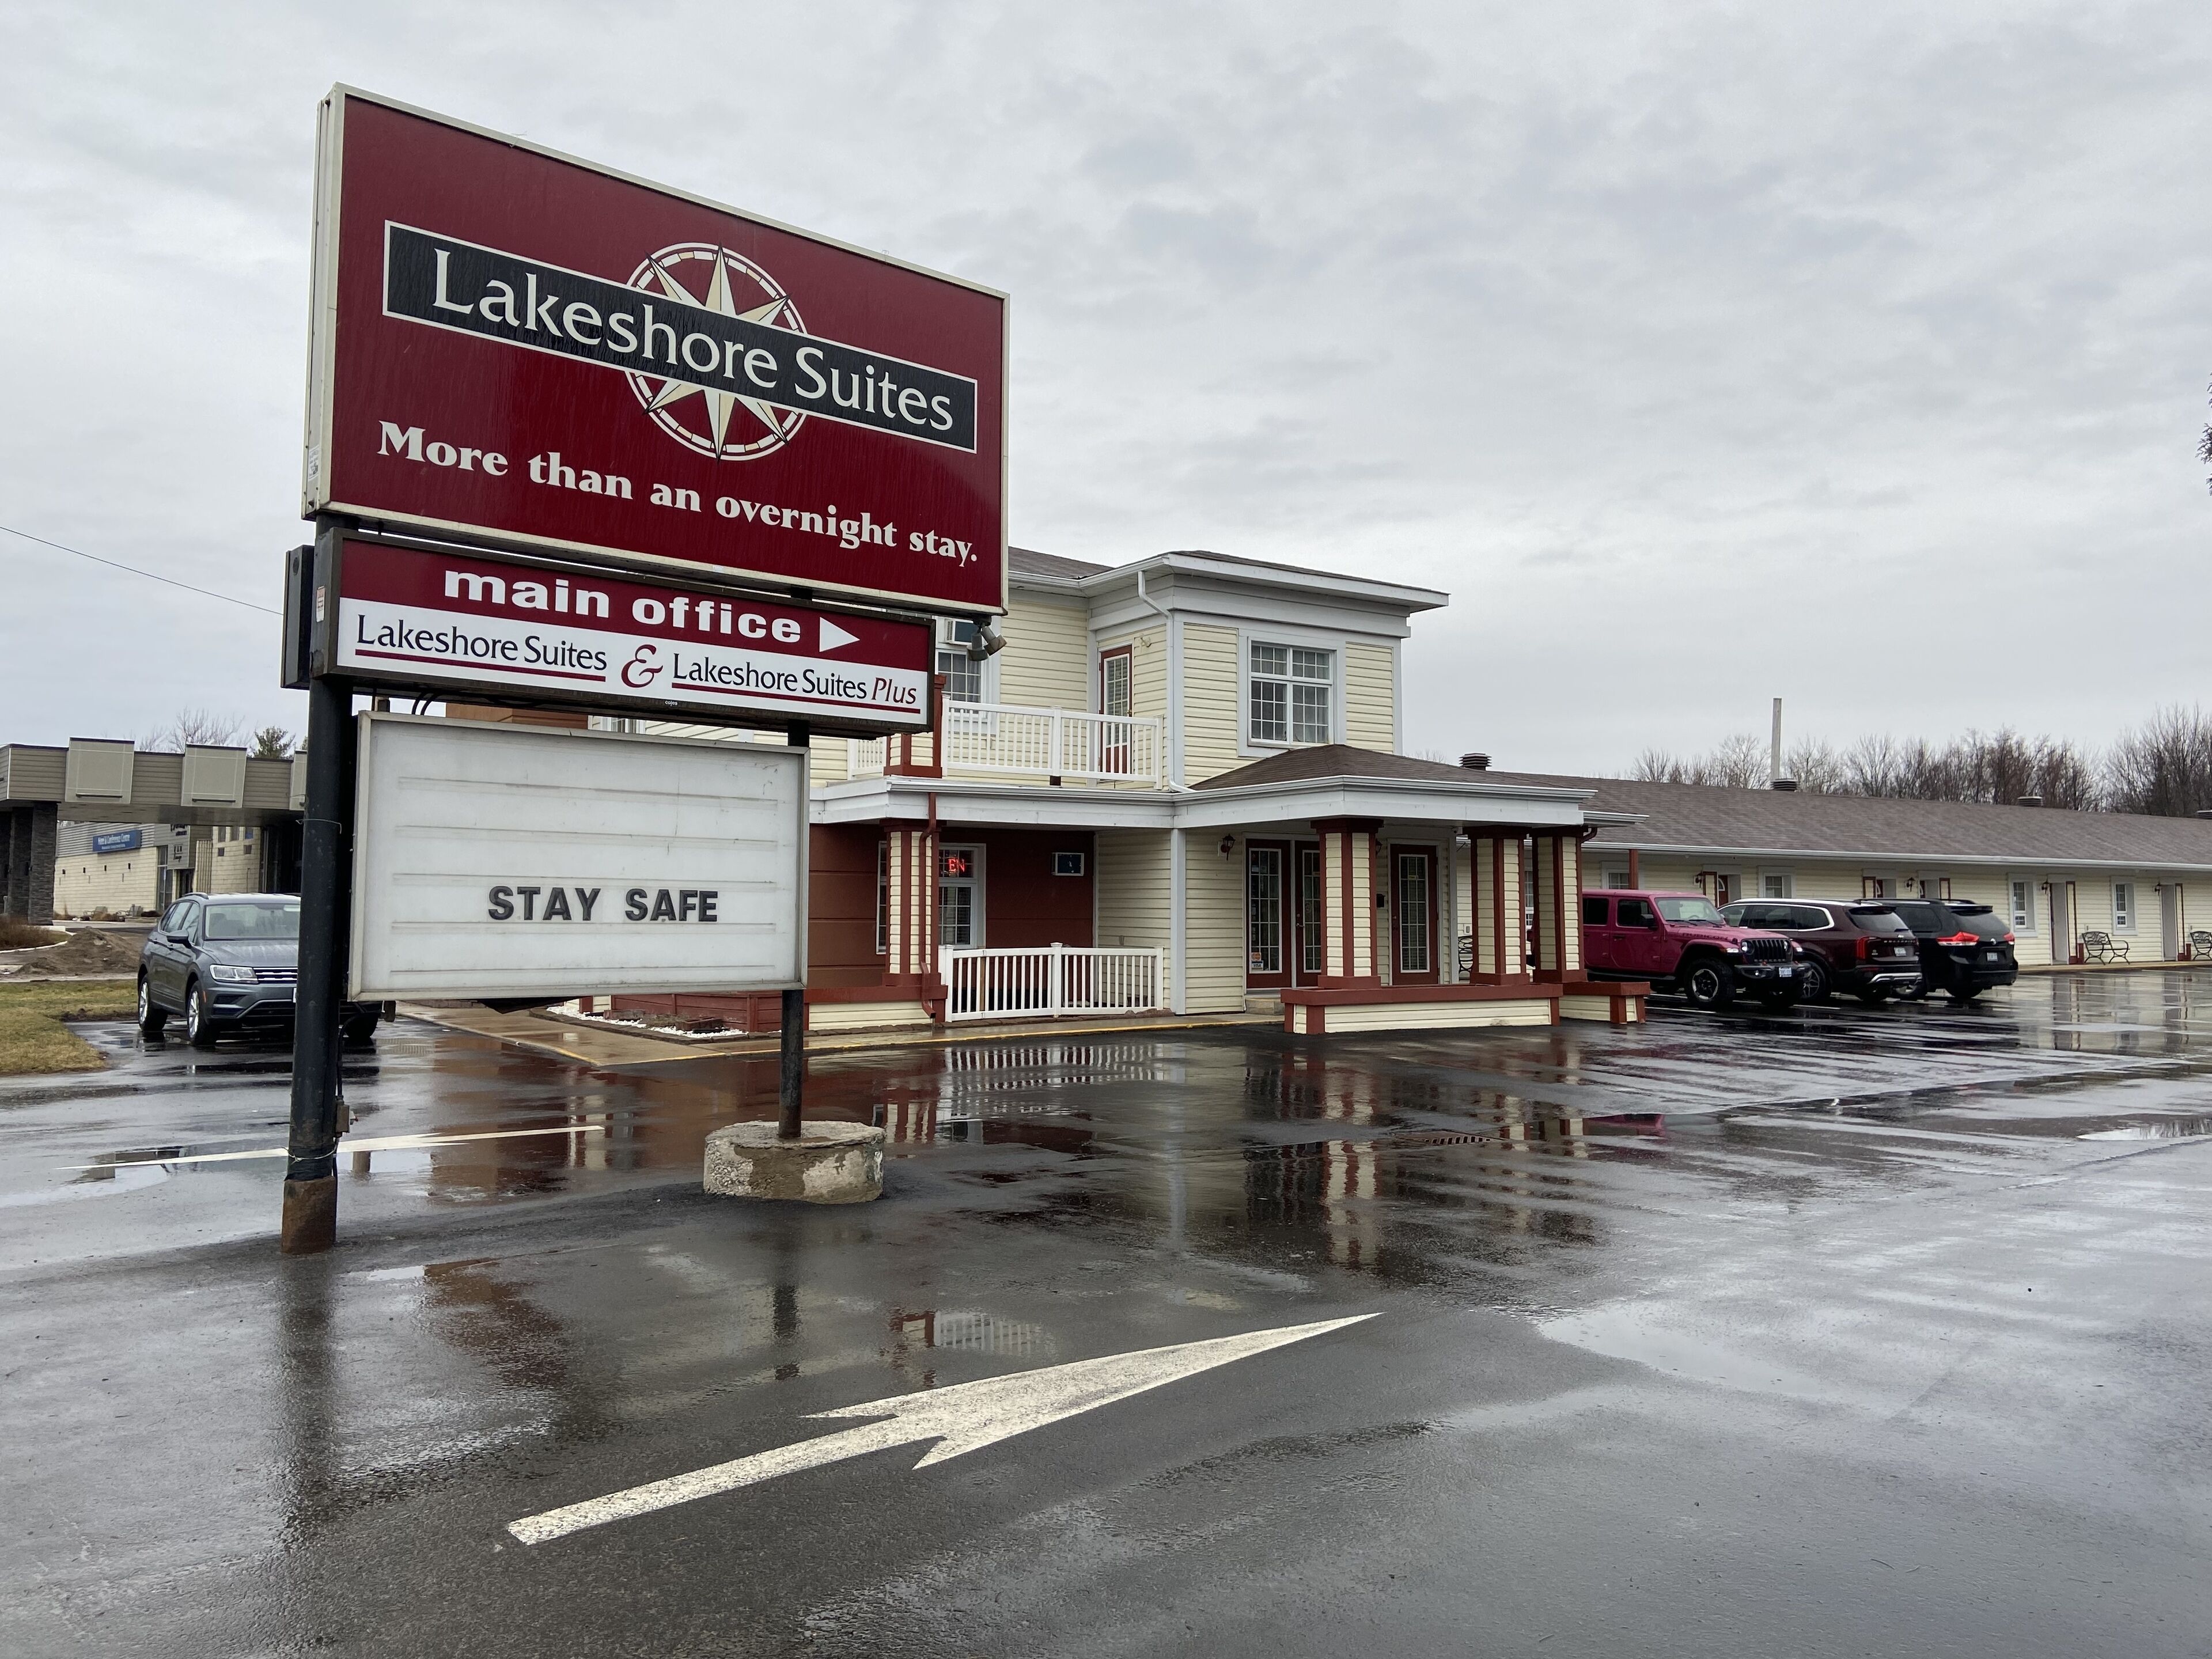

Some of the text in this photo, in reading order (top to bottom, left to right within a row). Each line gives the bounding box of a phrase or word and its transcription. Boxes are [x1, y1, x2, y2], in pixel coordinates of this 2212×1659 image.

[433, 248, 953, 430] Lakeshore Suites
[377, 421, 978, 567] More than an overnight stay.
[445, 571, 802, 643] main office
[357, 614, 917, 704] Lakeshore Suites & Lakeshore Suites Plus
[488, 885, 718, 922] STAY SAFE
